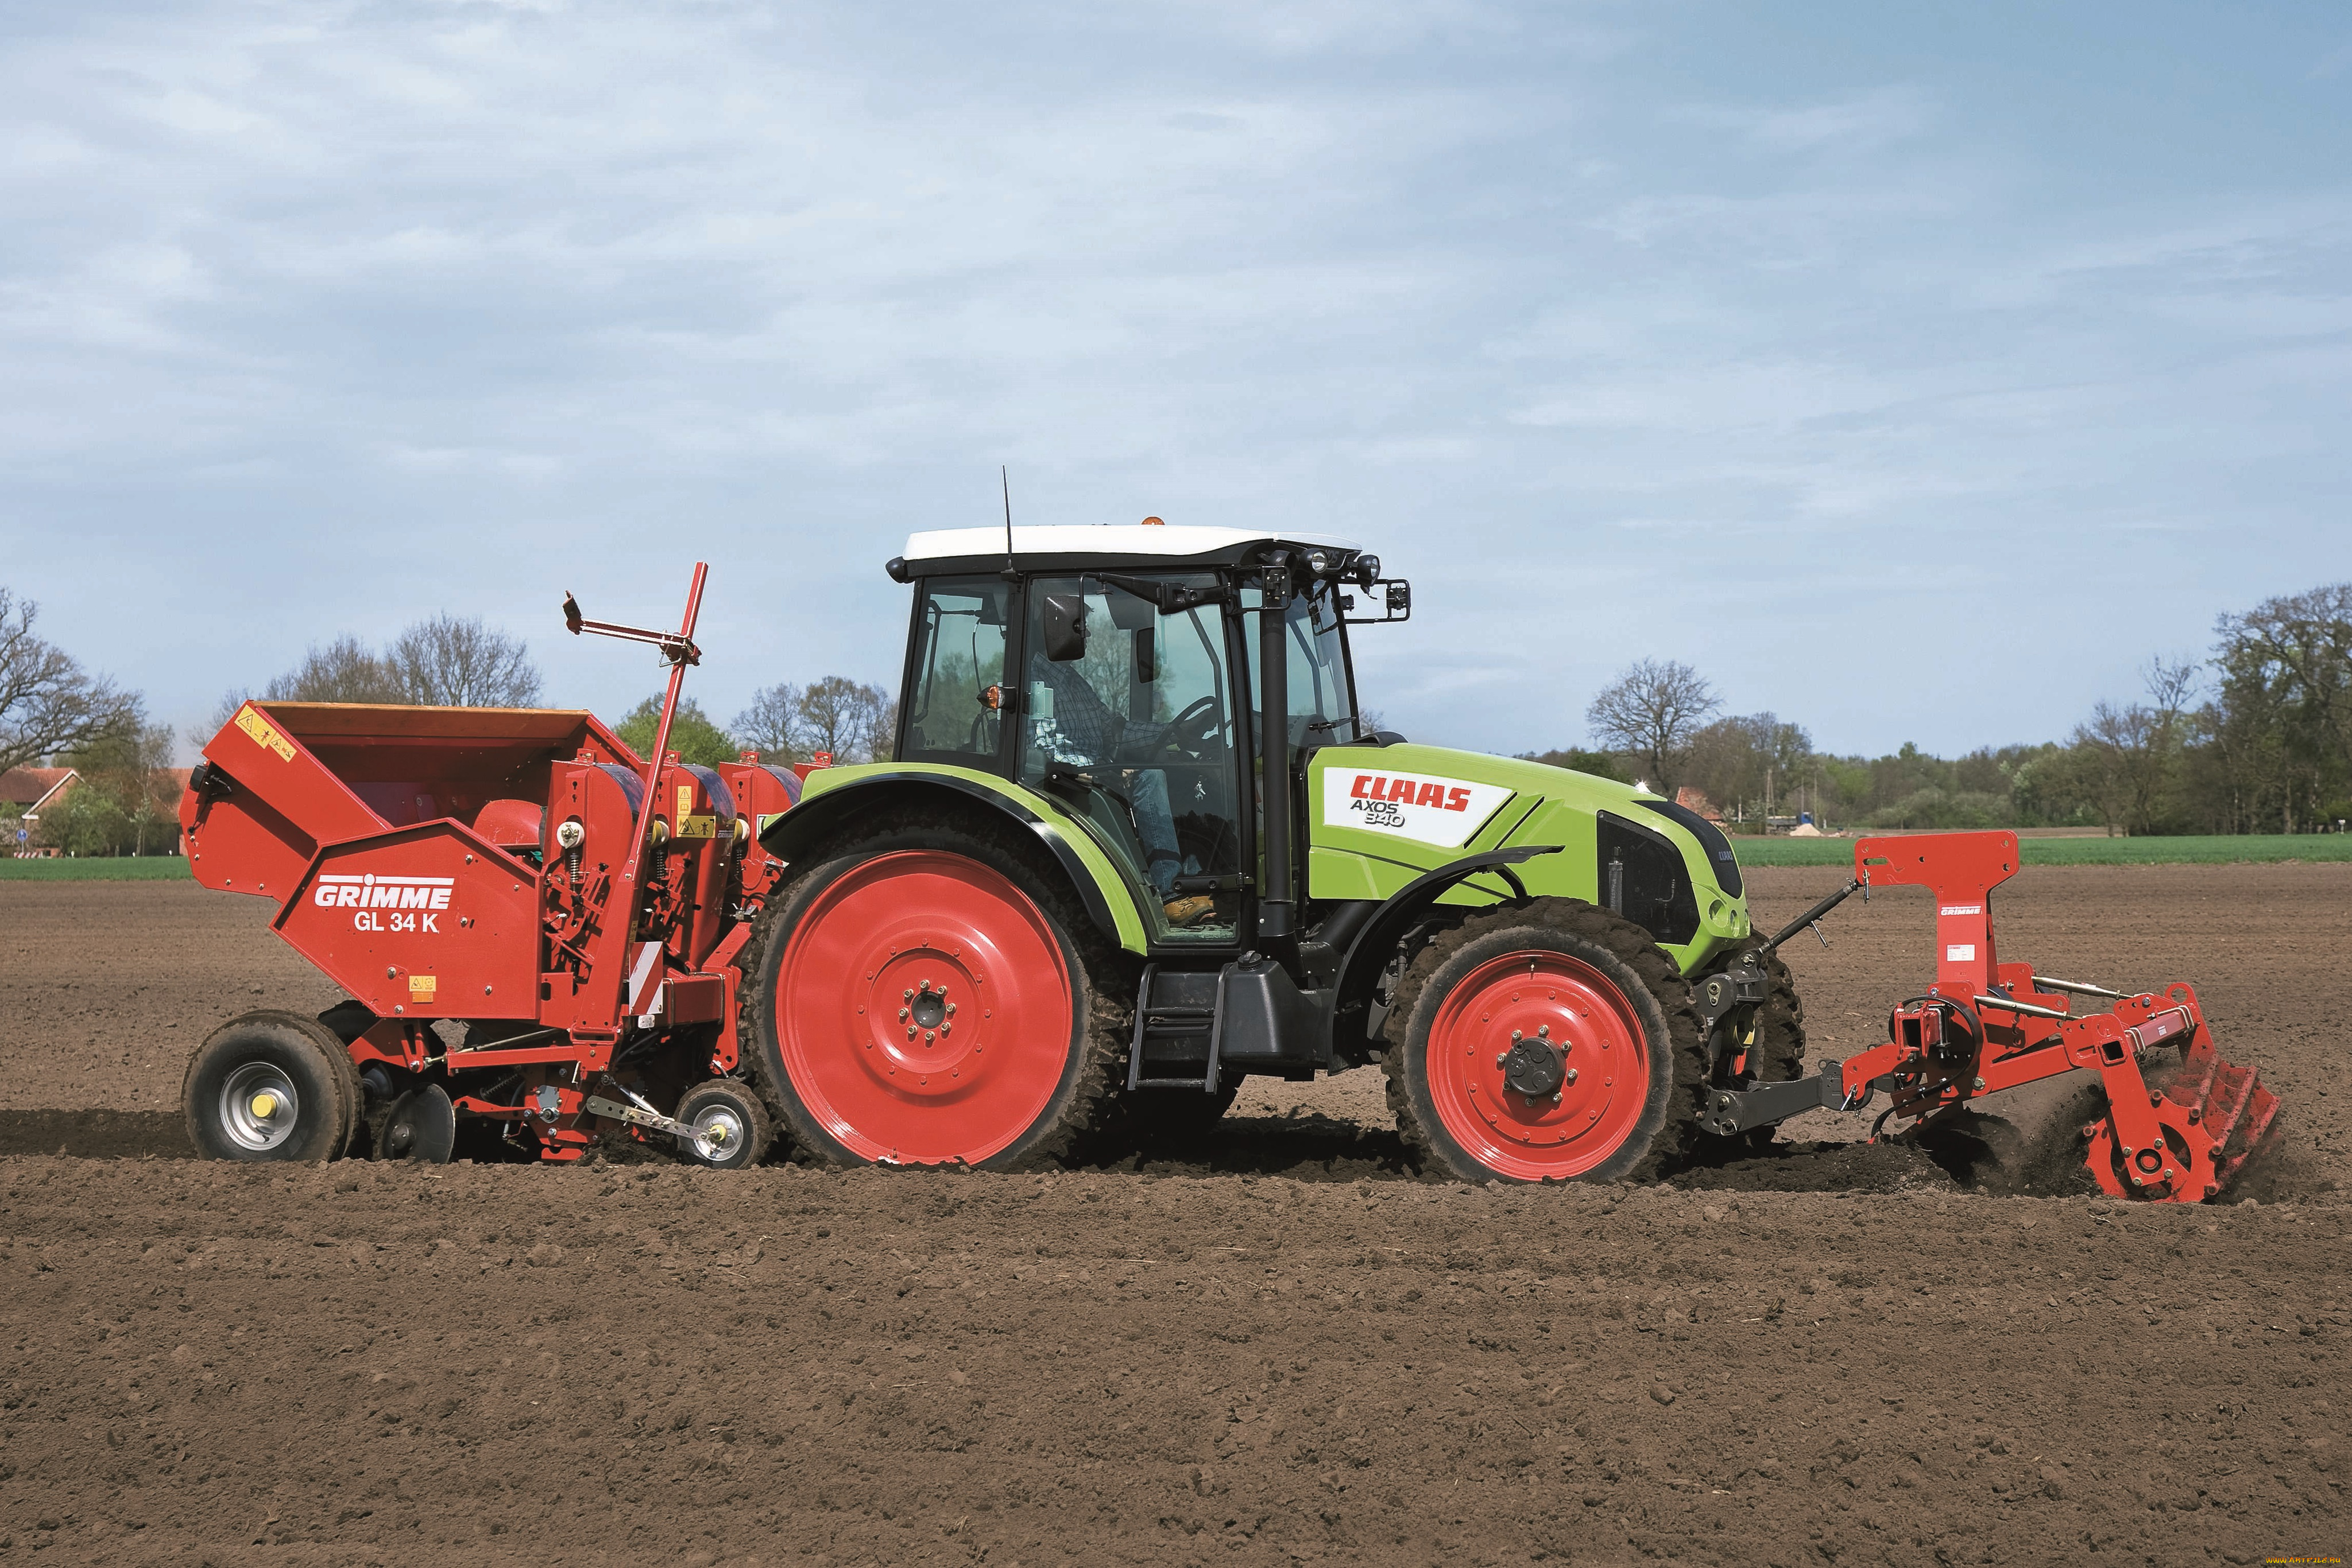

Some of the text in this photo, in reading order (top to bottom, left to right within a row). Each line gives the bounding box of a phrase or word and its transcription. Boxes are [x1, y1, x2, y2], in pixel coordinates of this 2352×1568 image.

[1351, 775, 1472, 812] CLAAS
[1351, 800, 1399, 814] AXOS
[1364, 811, 1406, 827] 340
[315, 873, 452, 909] GRIMME
[1940, 906, 1980, 916] GRIMME
[354, 911, 439, 933] GL 34 K
